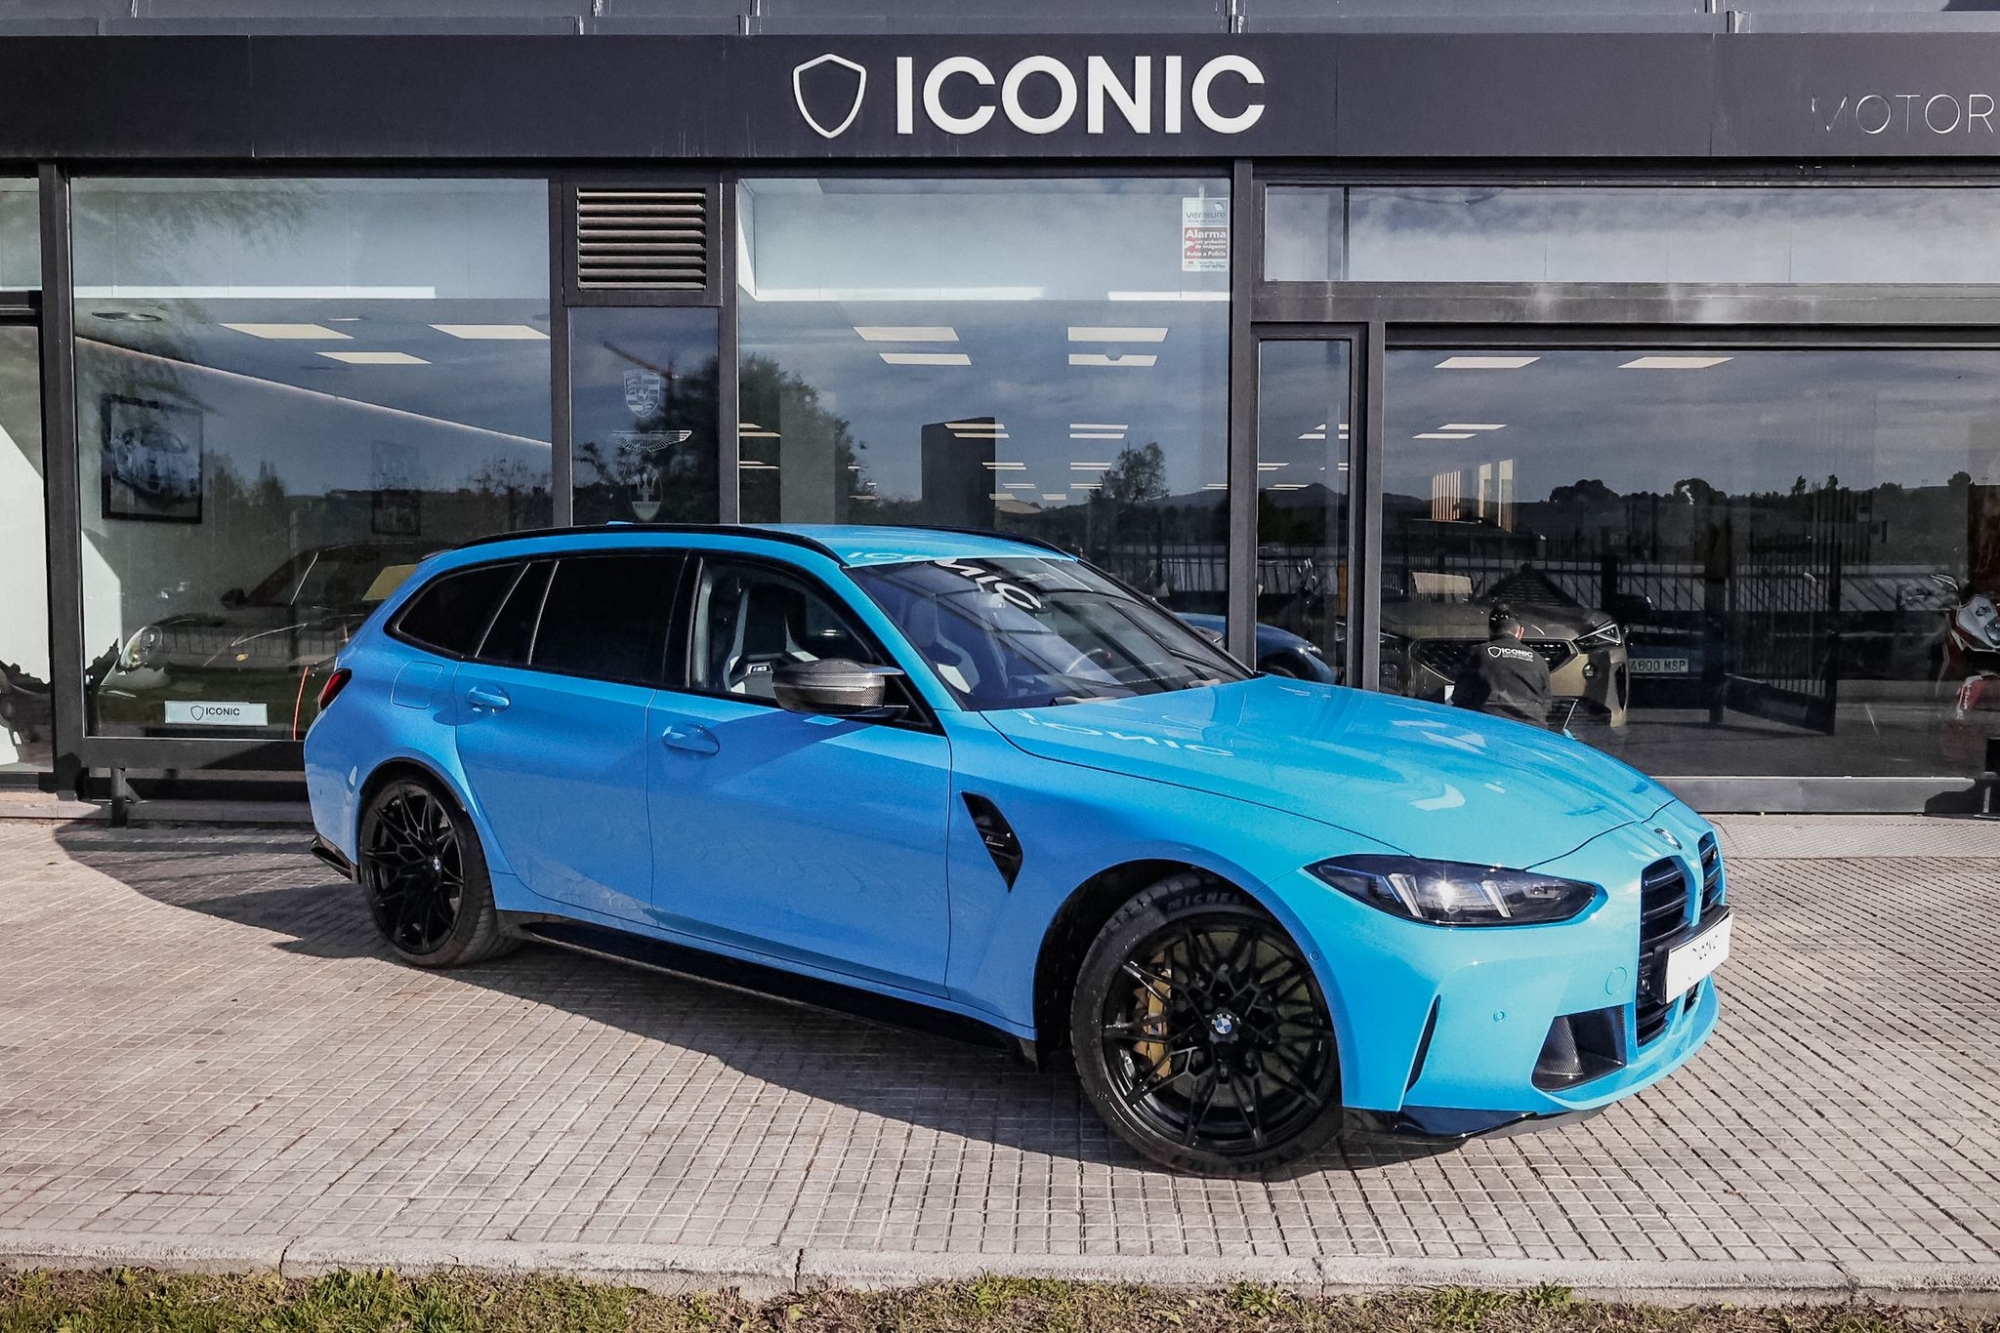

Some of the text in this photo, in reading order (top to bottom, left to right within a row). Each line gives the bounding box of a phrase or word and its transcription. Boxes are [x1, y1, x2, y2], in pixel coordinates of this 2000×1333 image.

[896, 54, 1266, 135] ICONIC
[1186, 229, 1226, 239] Alarma
[1501, 648, 1534, 658] ICONIC
[1664, 660, 1686, 671] MSP
[205, 707, 241, 716] ICONIC
